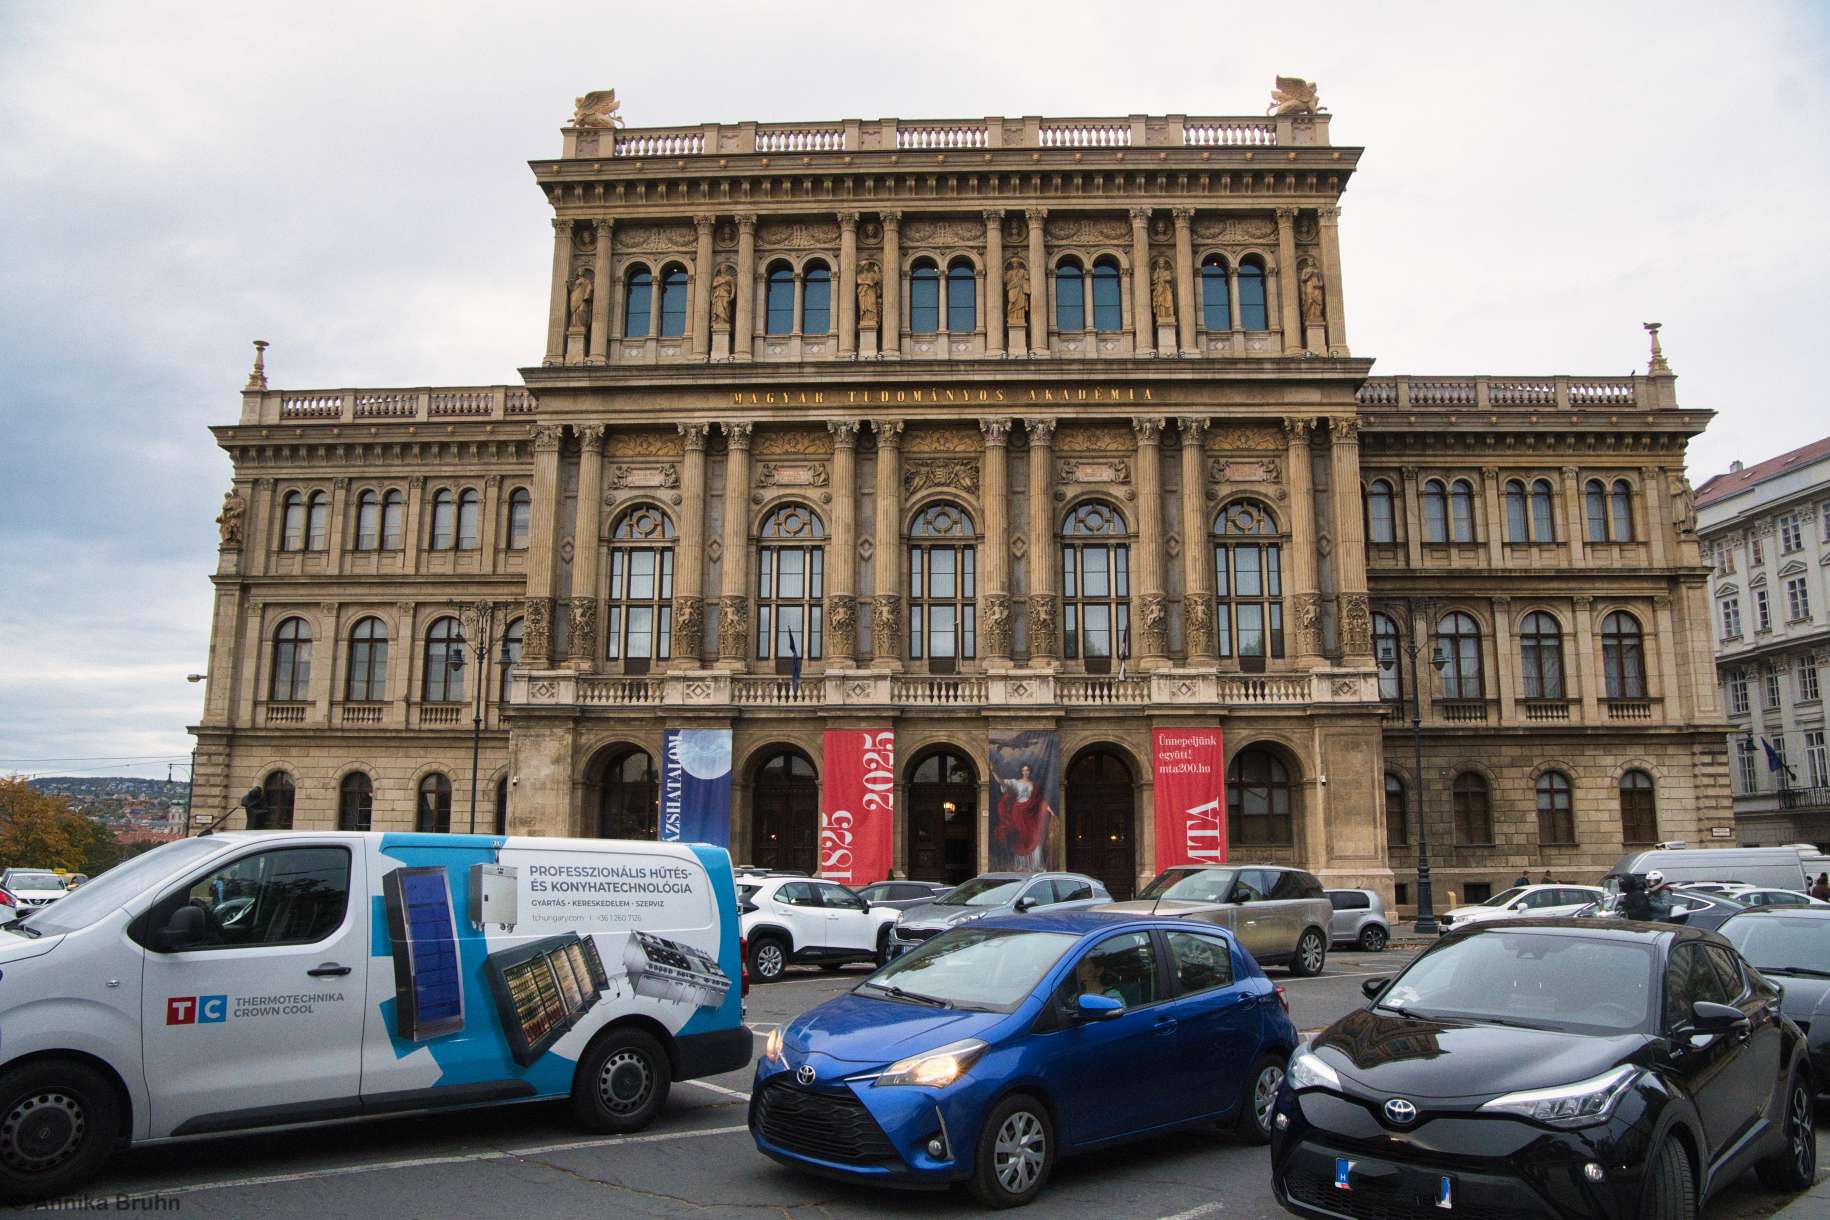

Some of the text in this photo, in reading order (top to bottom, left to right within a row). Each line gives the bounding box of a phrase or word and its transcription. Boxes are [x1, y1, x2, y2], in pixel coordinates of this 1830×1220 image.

[735, 386, 1152, 404] MAGYAR TUDOMÁNYOS AKADÉMIA
[1159, 733, 1217, 748] Ünnepeljünk
[1159, 750, 1192, 761] együtt!
[863, 732, 894, 810] 2025
[1160, 763, 1211, 774] mta200.hu
[821, 810, 853, 882] 1825
[529, 864, 647, 879] PROFESSZIONÁLIS
[530, 879, 692, 894] ÉS KONYHATECHNOLÓGIA
[531, 899, 664, 908] GYÁRTÁS KERESKEDELEM SZERVIZ
[532, 913, 585, 923] tchungary.com
[235, 992, 345, 1007] THERMOTECHNIKA
[234, 1004, 315, 1018] CROWN COOL
[1340, 1173, 1346, 1182] H
